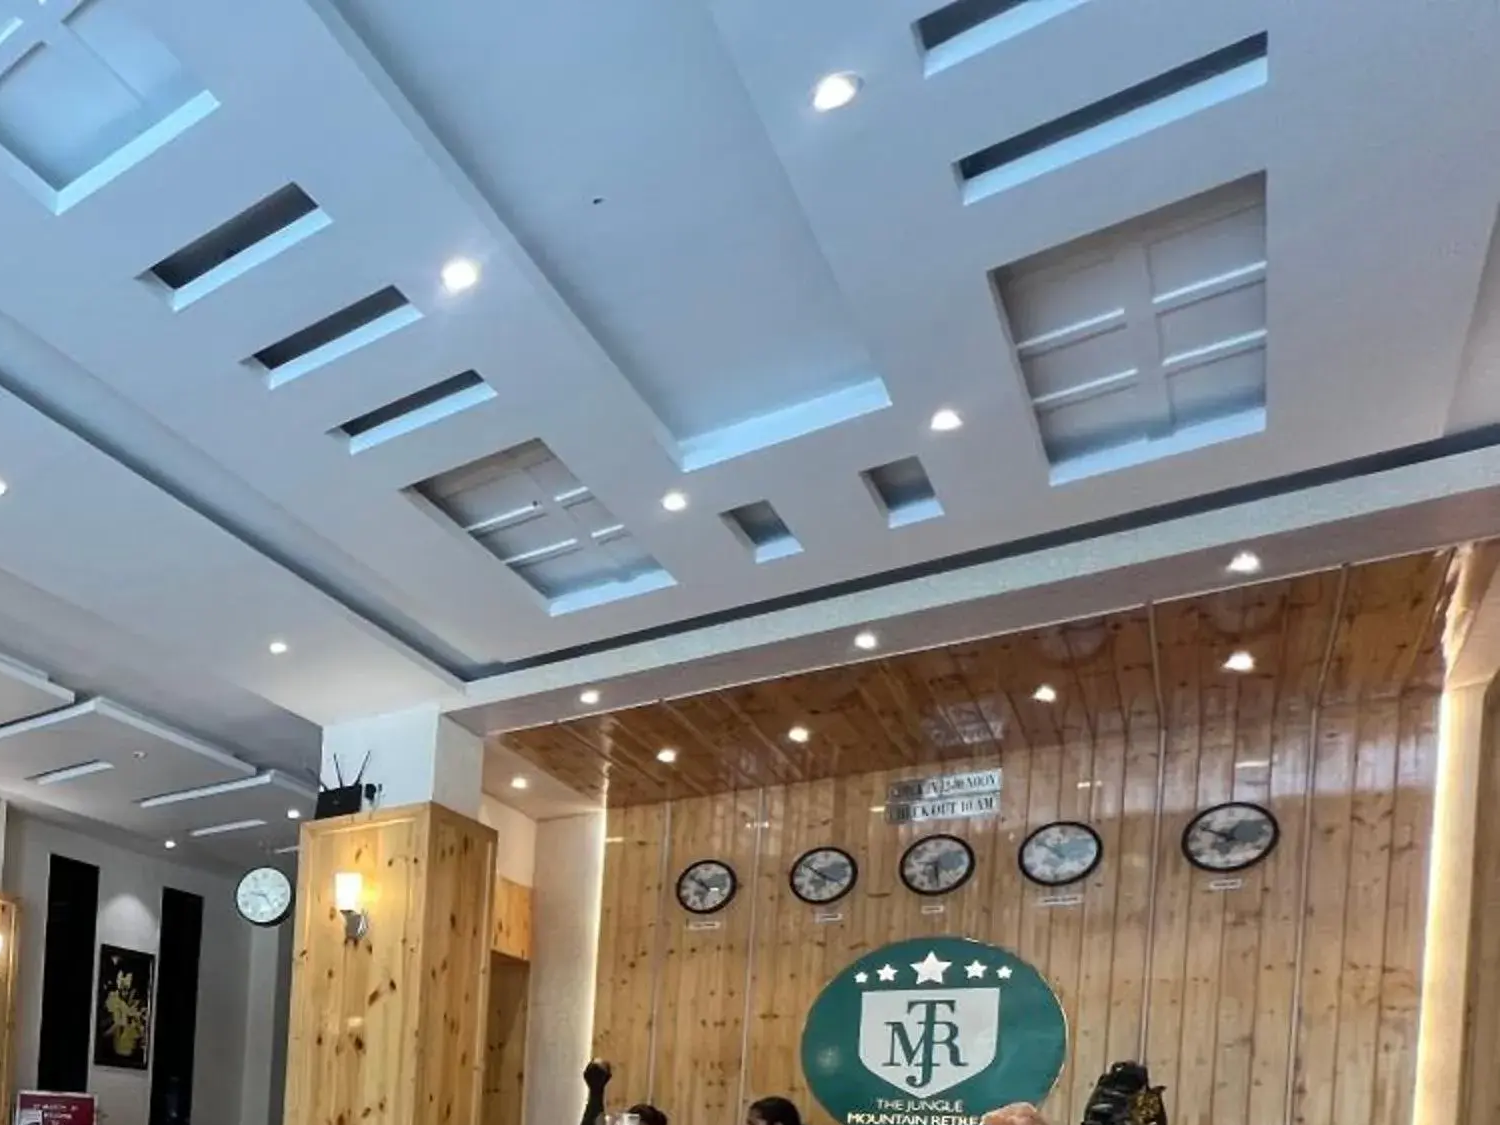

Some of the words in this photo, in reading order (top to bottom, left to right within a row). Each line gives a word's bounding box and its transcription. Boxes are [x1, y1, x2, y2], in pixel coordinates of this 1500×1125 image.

[931, 801, 956, 816] OUT
[978, 797, 993, 811] AM
[876, 1099, 904, 1111] THE
[906, 1099, 964, 1113] JUNGLE
[847, 1112, 928, 1125] MOUNTAIN
